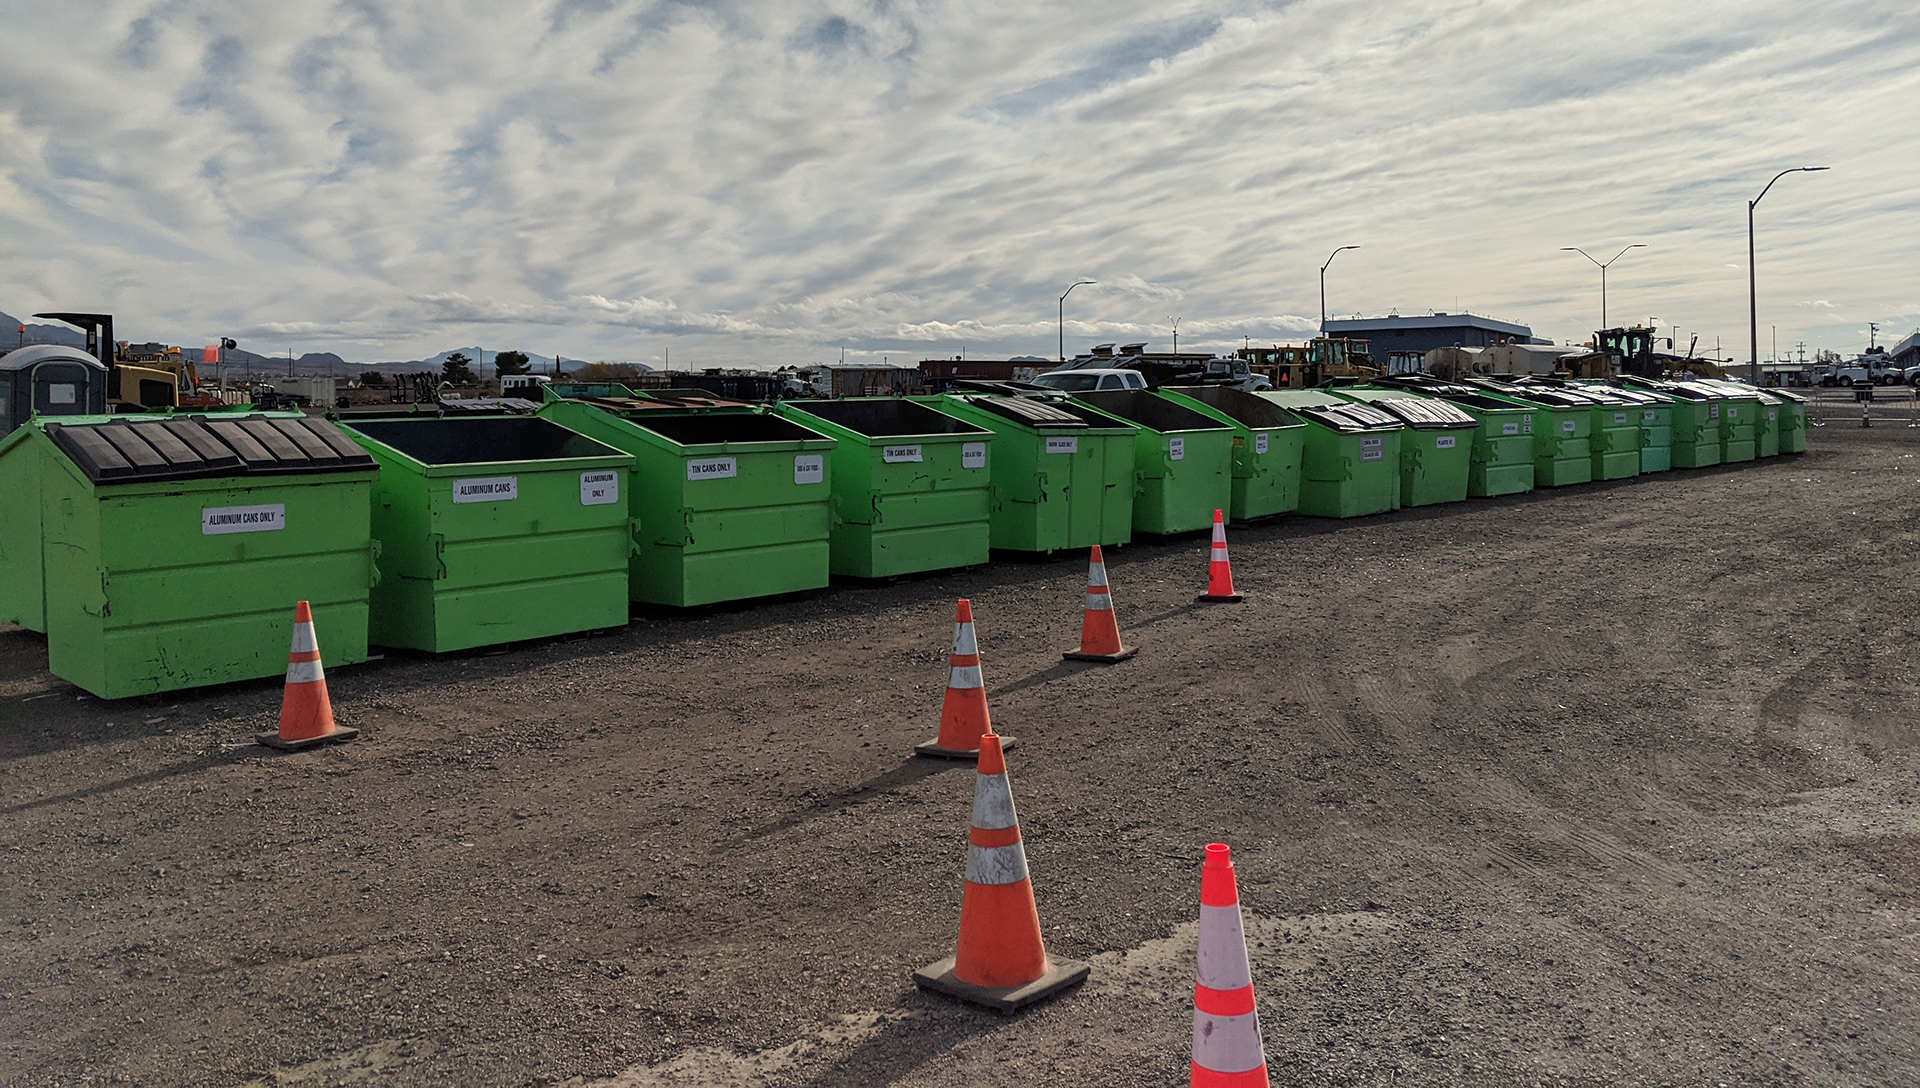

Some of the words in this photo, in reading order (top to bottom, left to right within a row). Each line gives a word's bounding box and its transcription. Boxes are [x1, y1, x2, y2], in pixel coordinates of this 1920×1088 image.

[886, 449, 894, 457] TIN
[895, 448, 906, 457] CANS
[906, 447, 917, 456] ONLY
[691, 465, 702, 474] TIN
[701, 463, 717, 473] CANS
[717, 462, 732, 472] ONLY
[584, 473, 614, 484] ALUMINUM
[460, 484, 493, 496] ALUMINUM
[494, 482, 511, 494] CANS
[592, 489, 605, 498] ONLY
[208, 513, 242, 526] ALUMINUM
[242, 511, 259, 524] CANS
[260, 511, 276, 523] ONLY
